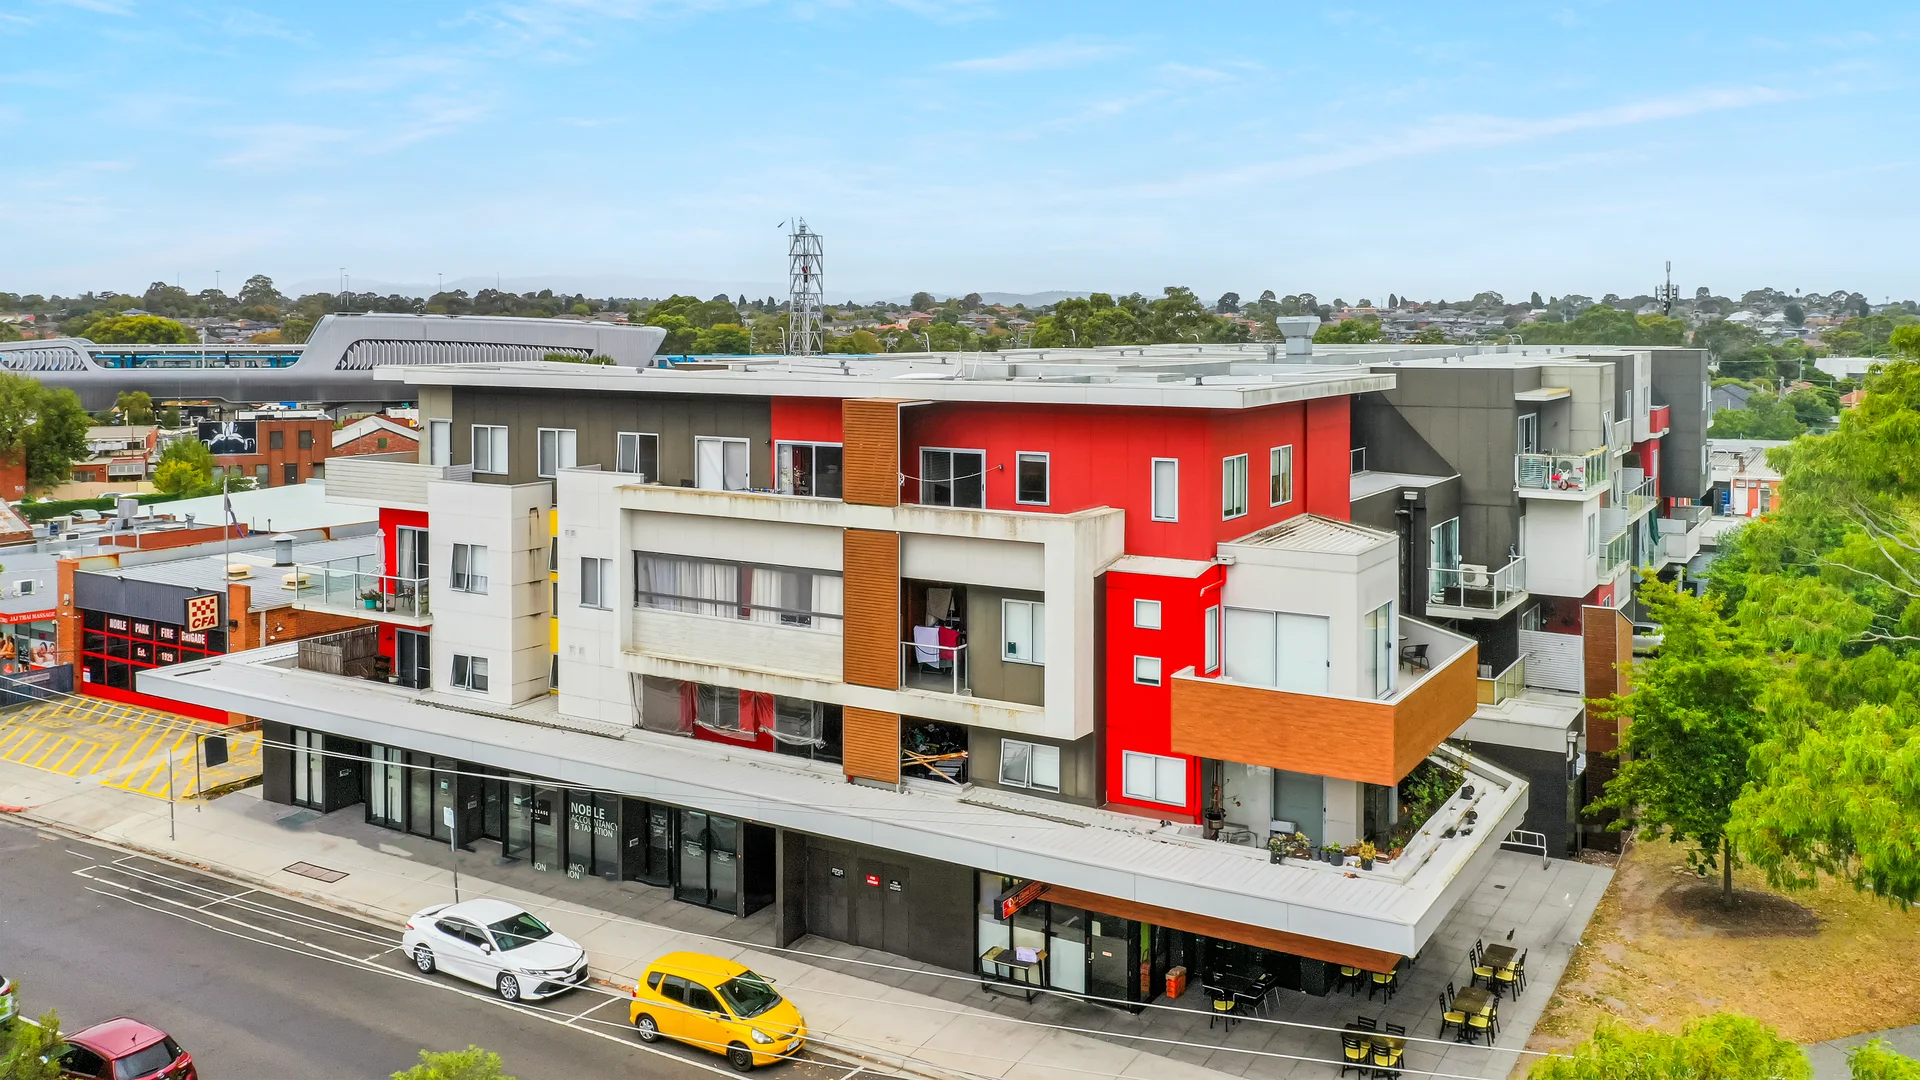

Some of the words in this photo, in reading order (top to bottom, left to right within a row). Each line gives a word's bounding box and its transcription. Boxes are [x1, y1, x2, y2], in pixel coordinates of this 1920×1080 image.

[191, 615, 216, 629] CFA
[109, 618, 127, 631] NOBLE
[135, 623, 150, 635] PARK
[160, 627, 174, 639] FIRE
[181, 630, 206, 645] BRIGADE
[161, 652, 174, 662] 1929
[534, 808, 549, 816] LEASE
[571, 801, 605, 820] NOBLE
[574, 822, 580, 830] &
[580, 823, 613, 838] TAXATION
